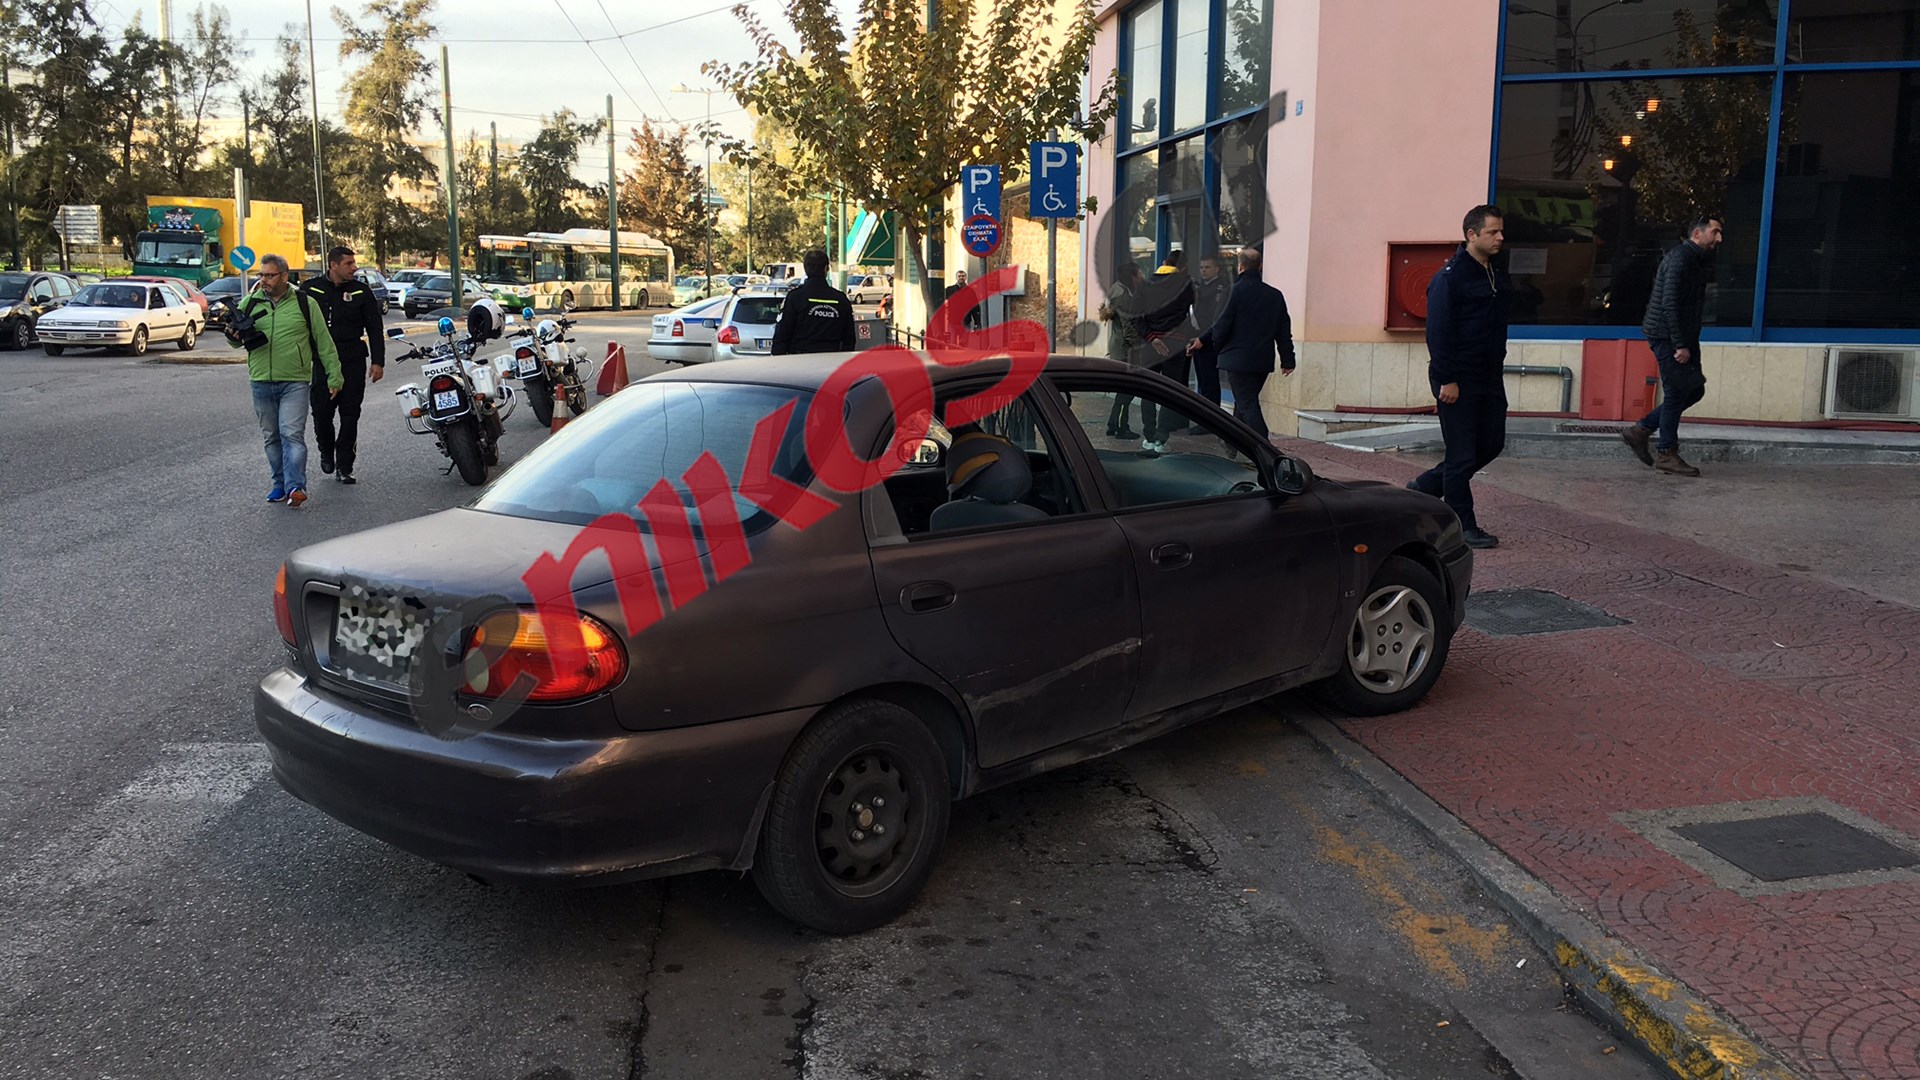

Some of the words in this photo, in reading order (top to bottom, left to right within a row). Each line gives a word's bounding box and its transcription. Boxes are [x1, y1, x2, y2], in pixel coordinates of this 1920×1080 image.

[1041, 146, 1068, 178] P
[970, 168, 993, 194] P
[814, 310, 835, 318] POLICE
[424, 365, 454, 377] POLICE
[437, 397, 458, 408] 4585
